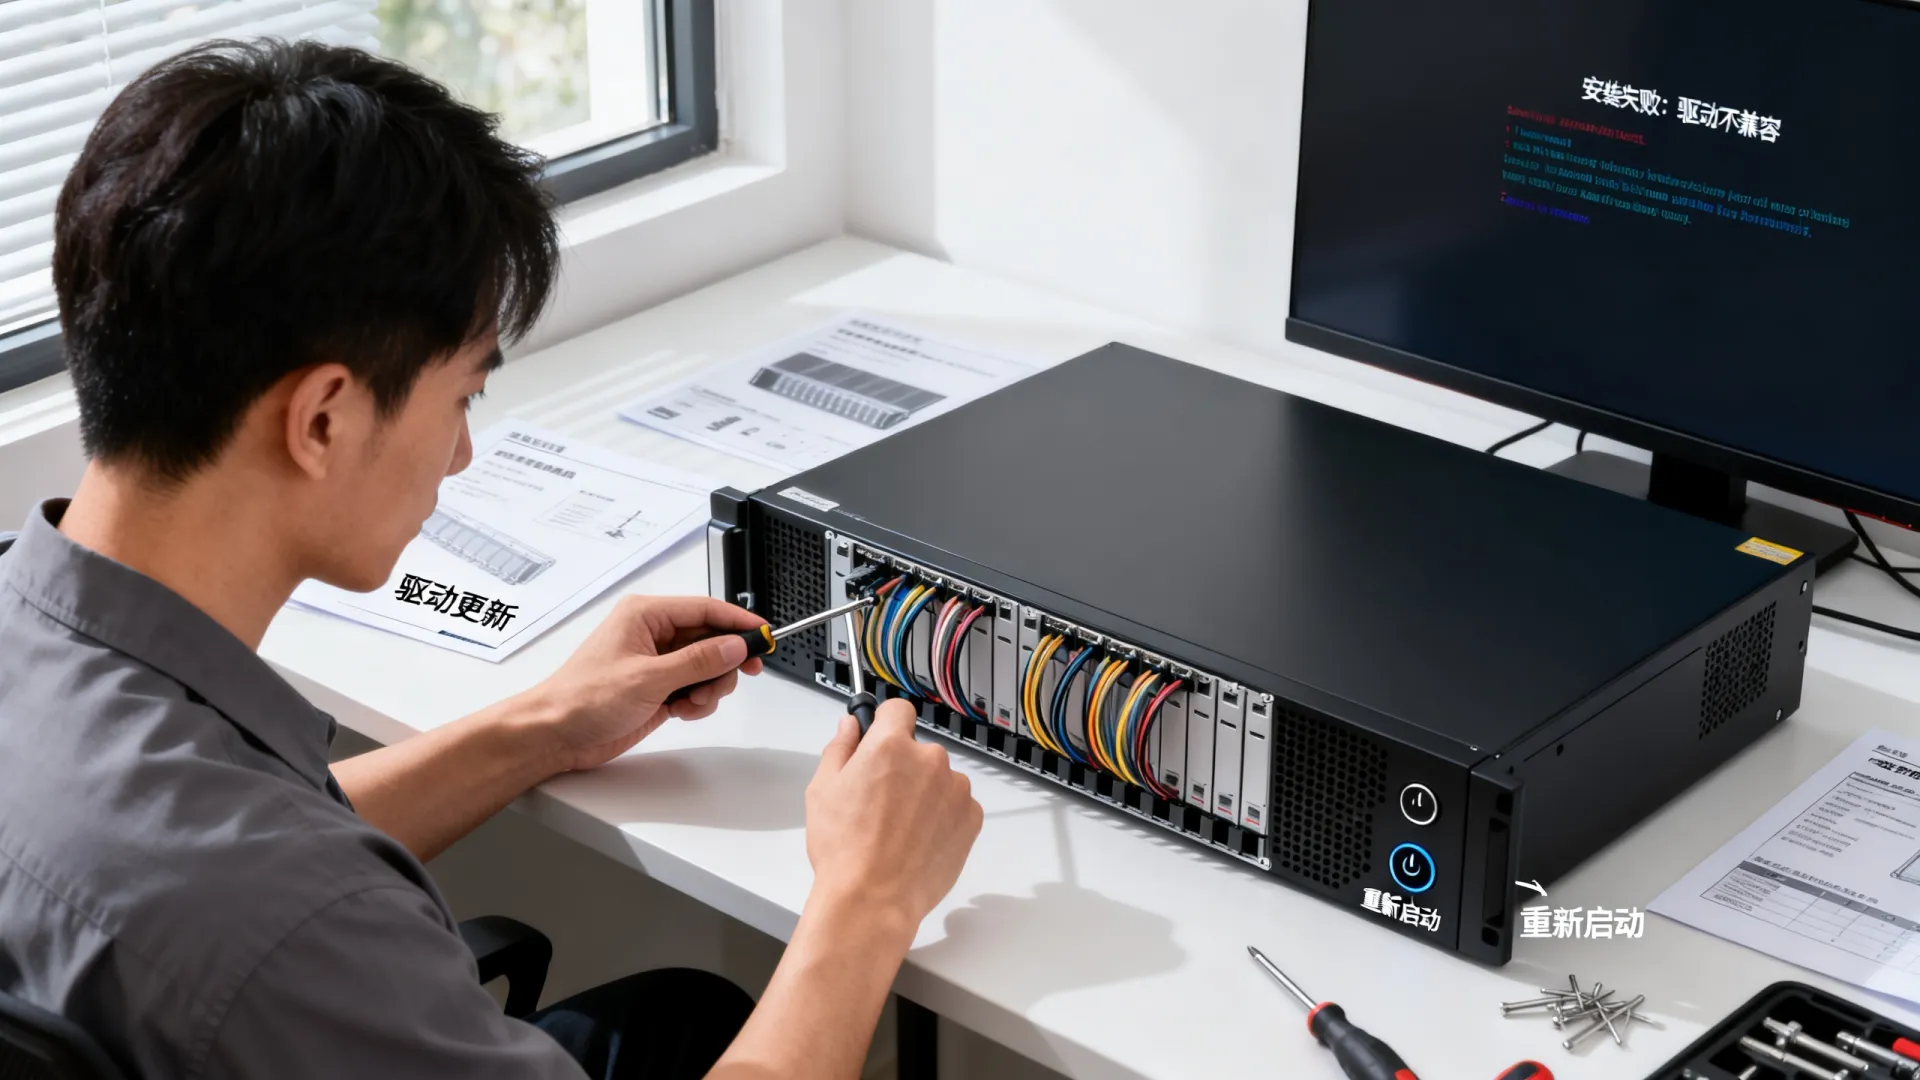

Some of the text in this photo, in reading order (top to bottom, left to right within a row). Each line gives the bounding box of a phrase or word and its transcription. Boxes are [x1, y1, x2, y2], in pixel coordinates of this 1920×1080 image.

[394, 573, 519, 631] 驱动更新
[1360, 886, 1442, 933] 重新启动
